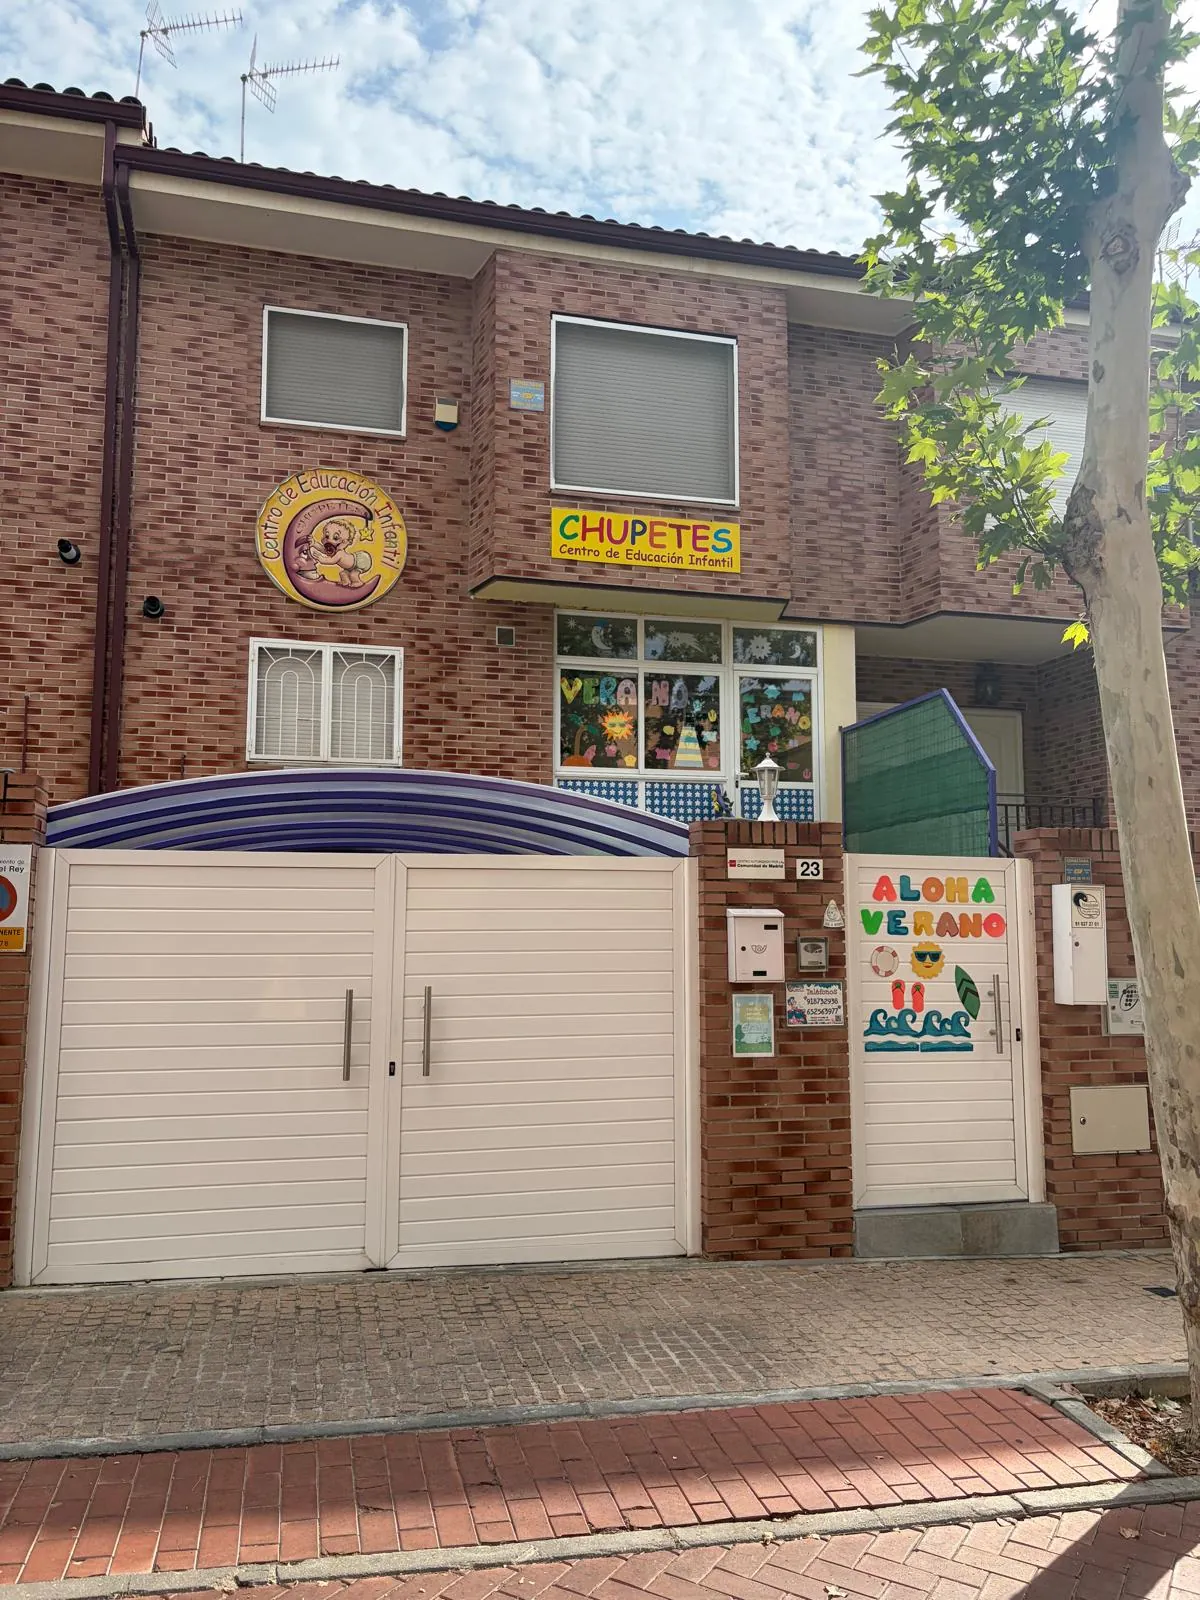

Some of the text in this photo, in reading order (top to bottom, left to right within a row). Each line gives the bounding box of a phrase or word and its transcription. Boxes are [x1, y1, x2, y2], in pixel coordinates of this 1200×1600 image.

[261, 470, 403, 570] Centro de Educación Infantil
[559, 514, 733, 554] CHUPETES
[559, 543, 734, 568] Centro de Educación Infantil
[9, 865, 25, 874] Rey
[800, 861, 820, 877] 23
[872, 875, 995, 904] ALOHA
[860, 908, 1006, 938] VERANO
